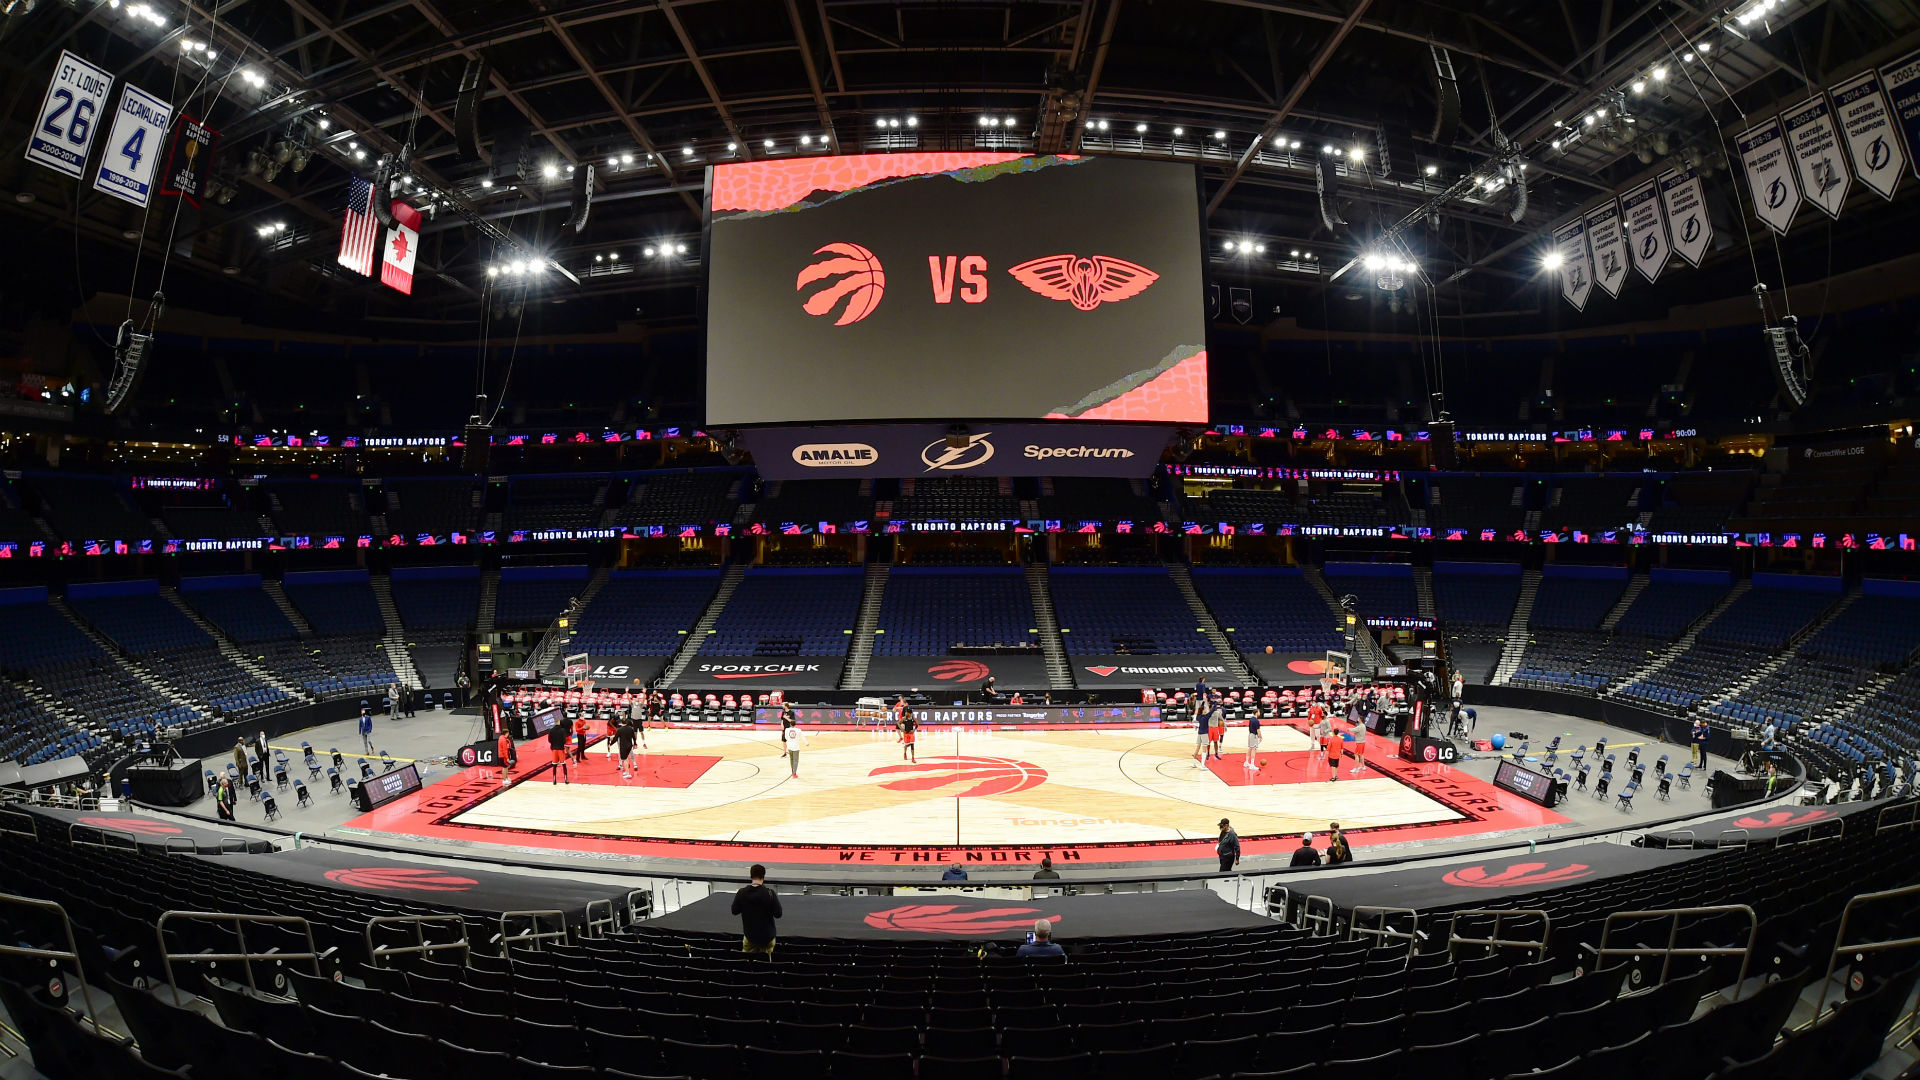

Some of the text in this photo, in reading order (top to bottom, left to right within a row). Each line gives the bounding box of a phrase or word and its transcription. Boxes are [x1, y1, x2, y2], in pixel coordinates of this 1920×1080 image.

[61, 65, 106, 98] ST. LOUIS
[1842, 85, 1870, 103] 2014-15
[42, 86, 96, 148] 26
[122, 96, 166, 129] LECAVALIER
[1848, 101, 1875, 118] EASTERN
[1846, 108, 1885, 130] CONFERENCE
[188, 122, 211, 138] TORONTO
[1798, 124, 1824, 140] EASTERN
[1850, 118, 1886, 138] CHAMPIONS
[186, 129, 209, 146] RAPTORS
[1796, 130, 1833, 152] CONFERENCE
[41, 143, 77, 164] 2000-2014
[120, 126, 148, 172] 4
[1800, 140, 1834, 160] CHAMPIONS
[1756, 160, 1778, 174] TROPHY
[175, 174, 197, 190] WORLD
[1671, 185, 1694, 200] ATLANTIC
[1672, 200, 1700, 216] CHAMPIONS
[1674, 194, 1694, 208] DIVISION
[1632, 204, 1652, 218] ATLANTIC
[1632, 218, 1658, 235] CHAMPIONS
[1634, 213, 1652, 226] DIVISION
[1594, 236, 1619, 252] CHAMPIONS
[928, 254, 988, 304] VS
[1676, 429, 1696, 437] 90:00
[407, 438, 446, 446] RAPTORS
[800, 448, 874, 462] AMALIE
[1023, 444, 1127, 462] Spectrum
[1847, 447, 1864, 456] LOGE
[911, 522, 1006, 531] TORONTO RAPTORS
[1301, 527, 1384, 536] TORONTO RAPTORS
[533, 530, 615, 540] TORONTO RAPTORS
[1652, 534, 1728, 544] TORONTO RAPTORS
[186, 540, 262, 550] TORONTO RAPTORS
[593, 666, 630, 674] LG
[934, 711, 992, 721] RAPTORS
[477, 750, 492, 762] LG
[1438, 748, 1454, 760] LG
[1396, 766, 1504, 813] RAPTORS
[840, 850, 1081, 862] WE THE NORTH
